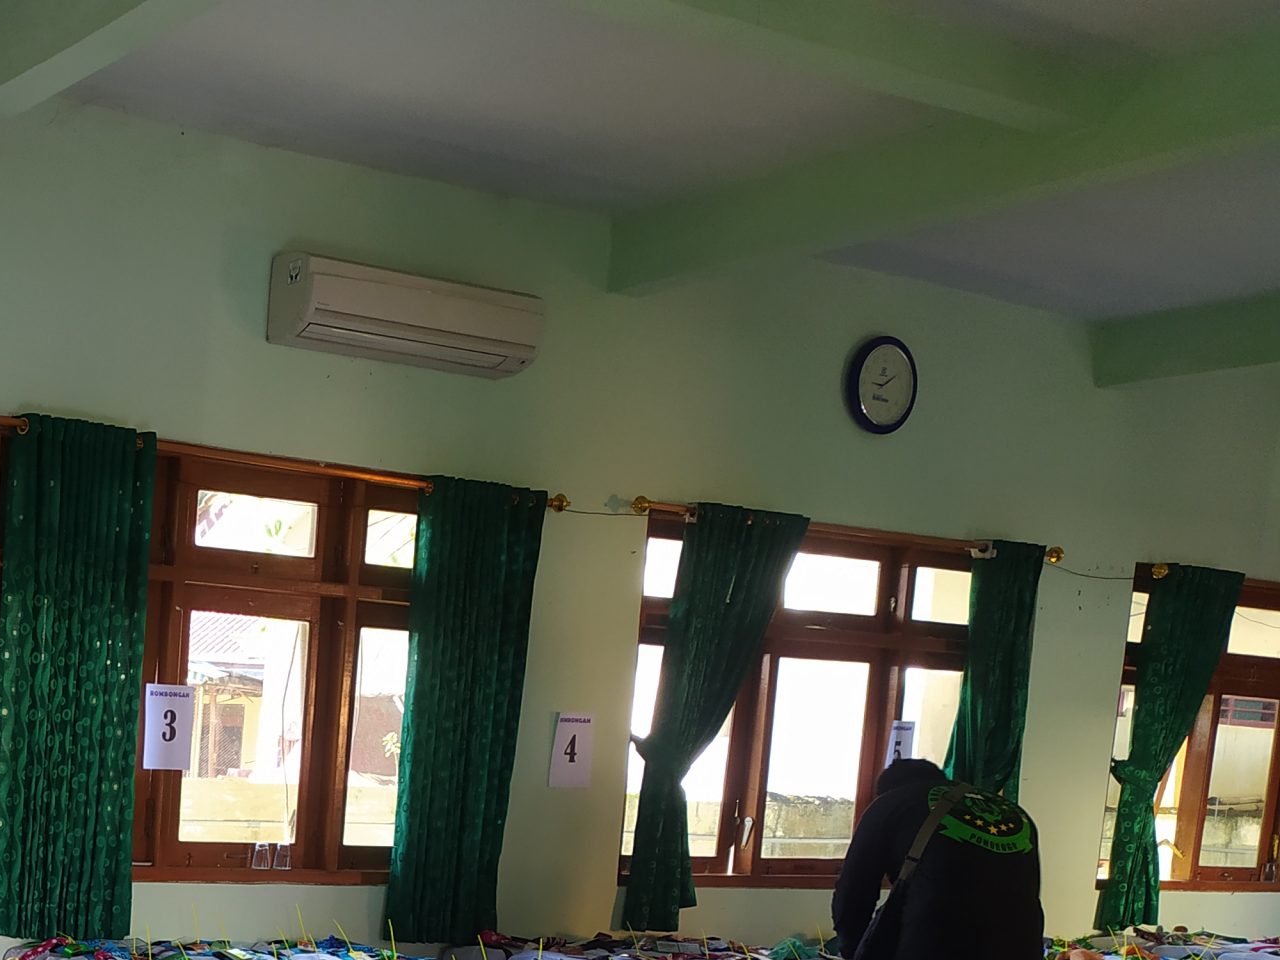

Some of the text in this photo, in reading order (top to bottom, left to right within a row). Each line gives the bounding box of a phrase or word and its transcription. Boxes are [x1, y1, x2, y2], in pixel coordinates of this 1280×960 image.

[149, 690, 190, 698] ROMBONGAN
[161, 709, 177, 742] 3
[564, 734, 577, 763] 4
